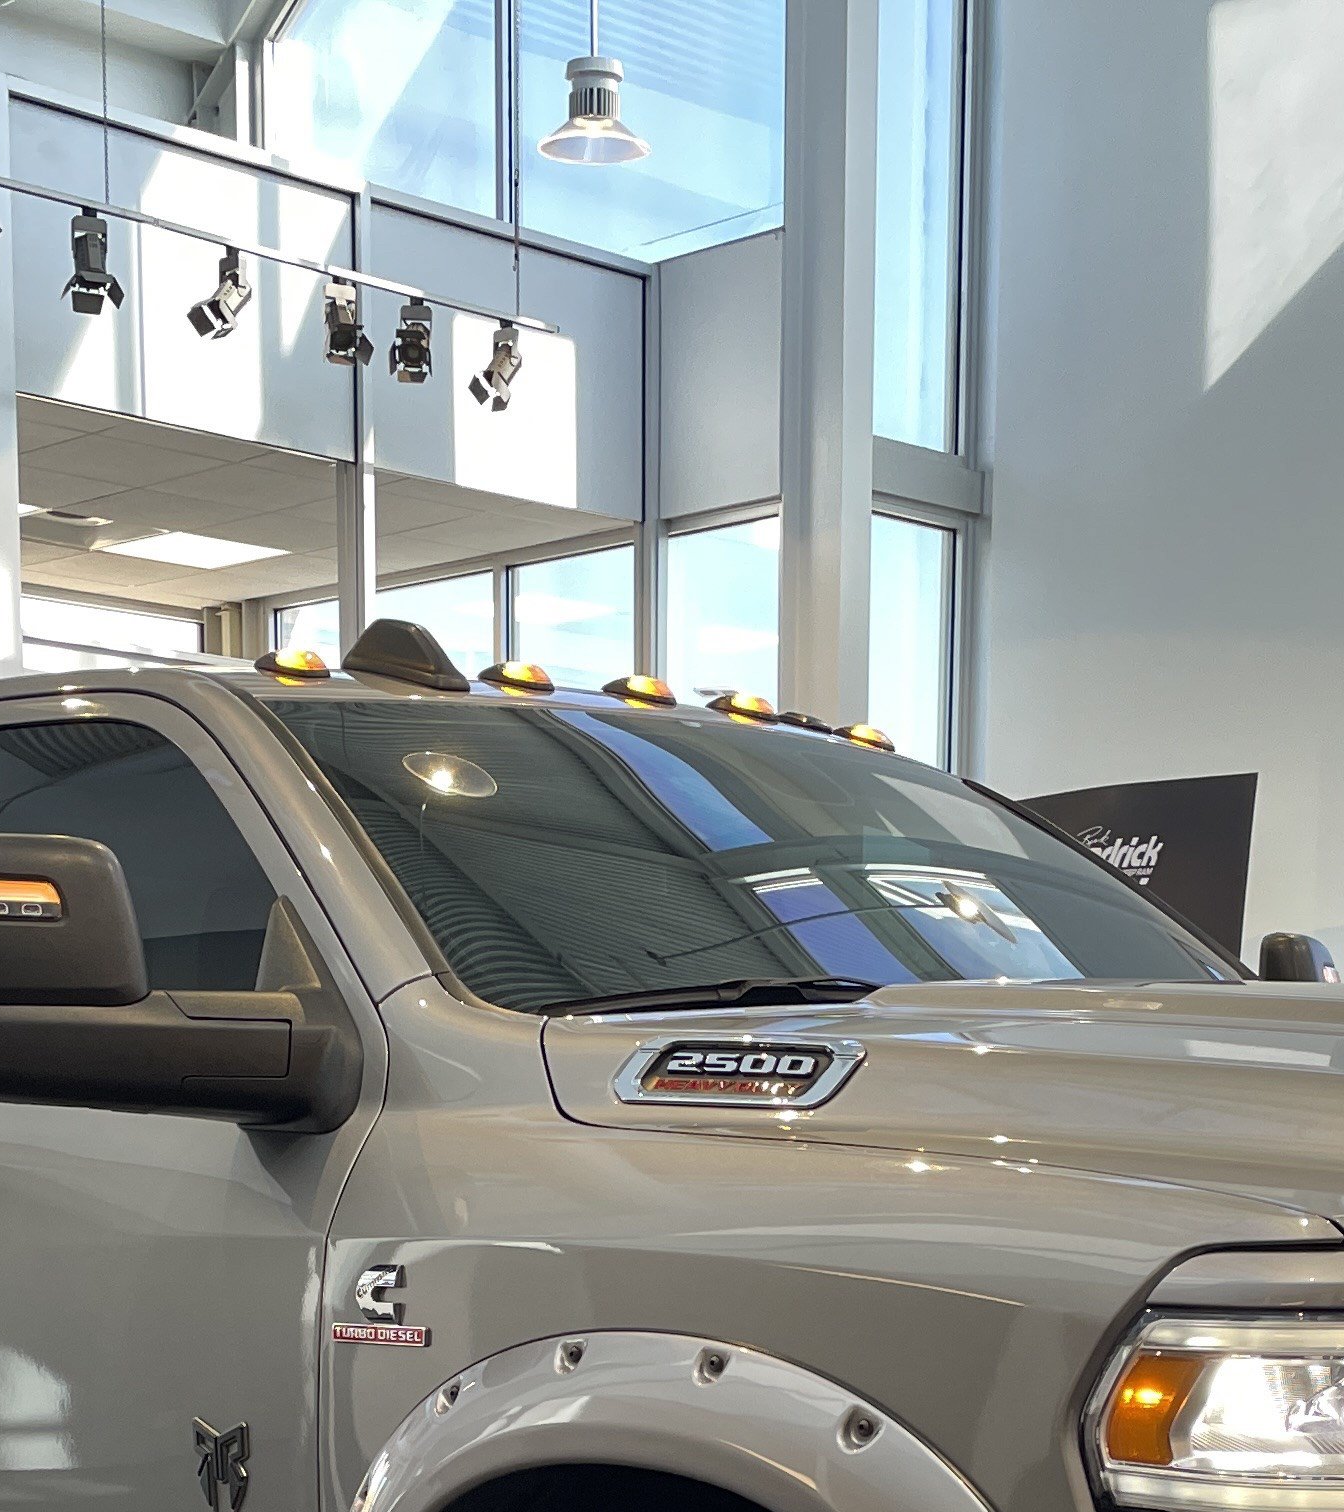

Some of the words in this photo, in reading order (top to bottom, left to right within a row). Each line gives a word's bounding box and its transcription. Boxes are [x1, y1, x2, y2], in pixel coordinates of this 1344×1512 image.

[1090, 835, 1164, 868] drick
[666, 1052, 817, 1078] 2500
[334, 1326, 376, 1340] TURBO
[377, 1329, 422, 1342] DIESEL
